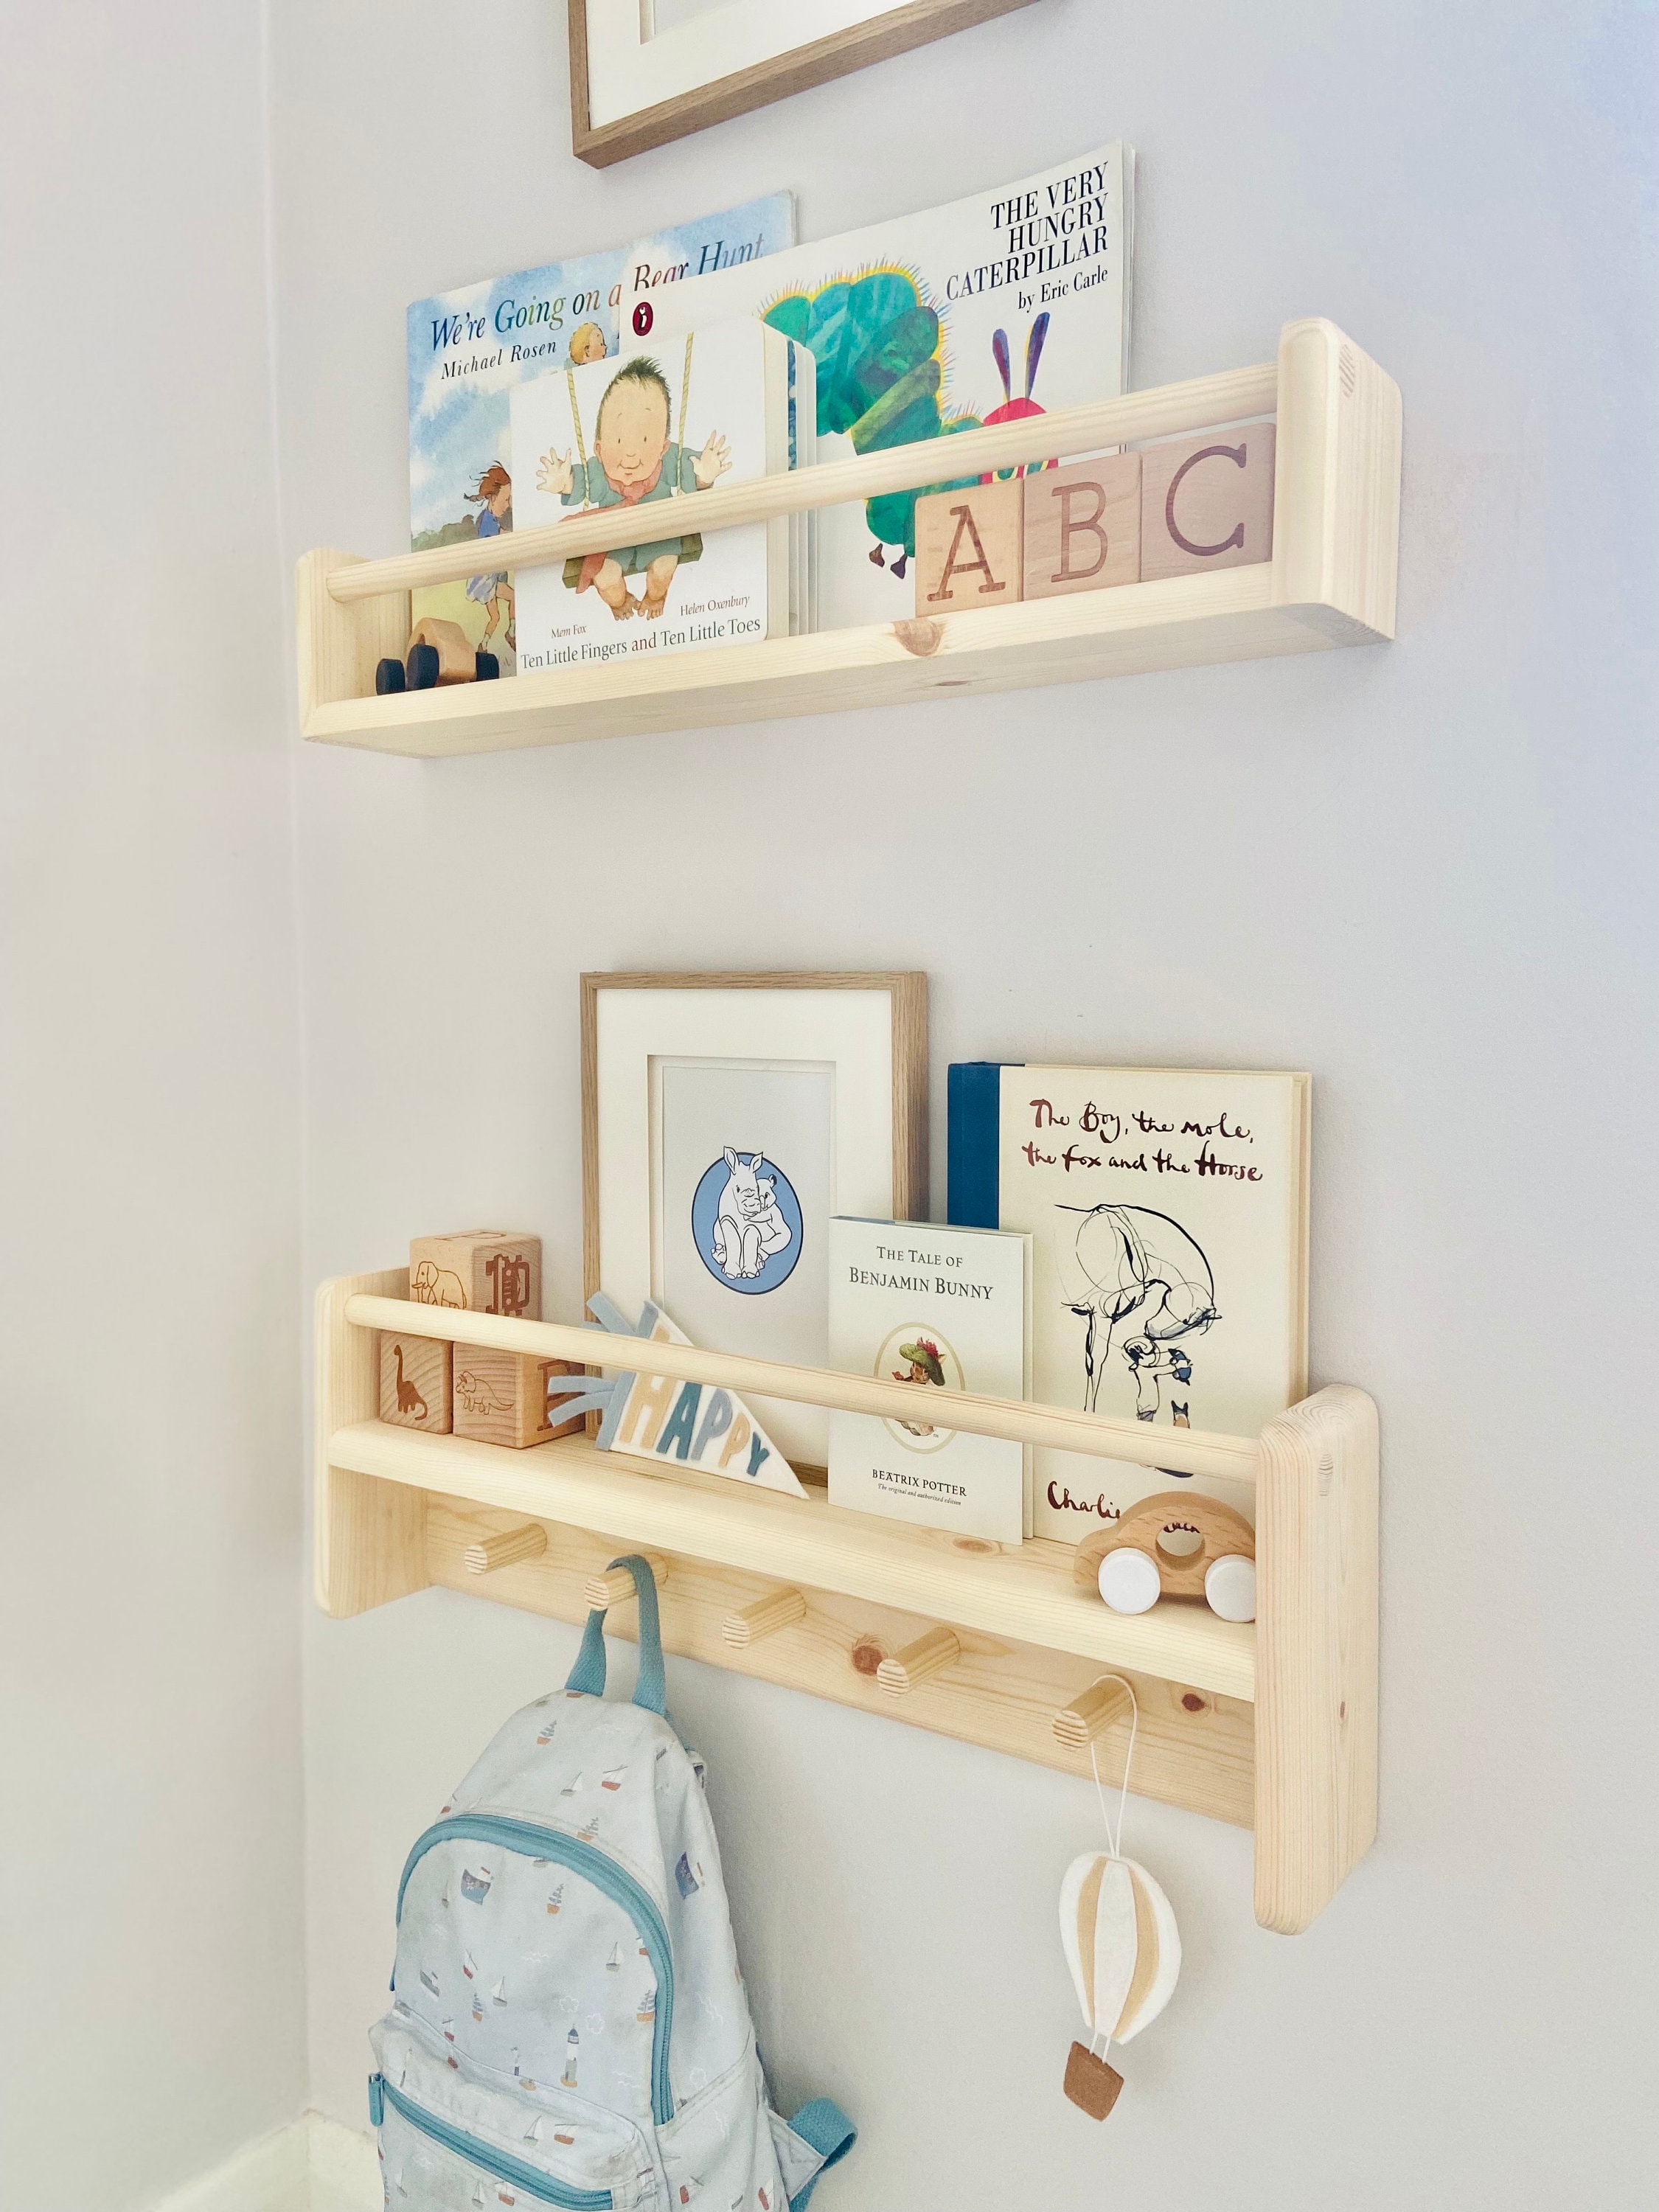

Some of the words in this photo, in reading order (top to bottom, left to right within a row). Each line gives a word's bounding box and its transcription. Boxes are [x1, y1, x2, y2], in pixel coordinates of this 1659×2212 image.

[991, 190, 1038, 229] THE
[1046, 161, 1108, 209] VERY
[1007, 192, 1108, 254] HUNGRY
[946, 226, 1108, 300] CATERPILLAR
[431, 312, 486, 352] We're
[494, 296, 566, 331] Going
[572, 289, 600, 315] on
[608, 284, 622, 307] a
[633, 262, 689, 292] Bear
[698, 233, 764, 275] Hunt
[1018, 291, 1034, 313] by
[1040, 279, 1068, 302] Eric
[1074, 265, 1108, 291] Carle
[440, 349, 502, 380] Michael
[510, 341, 557, 363] Rosen
[926, 504, 1006, 602] A
[1050, 481, 1108, 583] B
[1164, 442, 1248, 557] C
[680, 602, 705, 616] Helen
[707, 594, 751, 612] Oxenbury
[521, 653, 543, 669] Ten
[546, 646, 578, 666] Little
[581, 641, 627, 661] Fingers
[631, 632, 656, 652] and
[661, 630, 685, 646] Ten
[689, 622, 725, 642] Little
[728, 617, 761, 636] Toes
[551, 627, 571, 639] Mem
[573, 625, 588, 635] Fox
[1029, 1099, 1069, 1128] The
[1079, 1102, 1129, 1144] Boy,
[1132, 1110, 1175, 1133] the
[1022, 1141, 1057, 1166] the
[1108, 1153, 1147, 1172] and
[1152, 1148, 1190, 1173] the
[1194, 1140, 1263, 1181] Horse
[619, 1325, 771, 1477] HAPPY
[872, 1469, 919, 1487] BEATRIX
[922, 1479, 967, 1497] POTTER
[877, 1483, 887, 1491] The
[888, 1486, 907, 1495] original
[907, 1489, 917, 1498] and
[944, 1498, 961, 1506] edition
